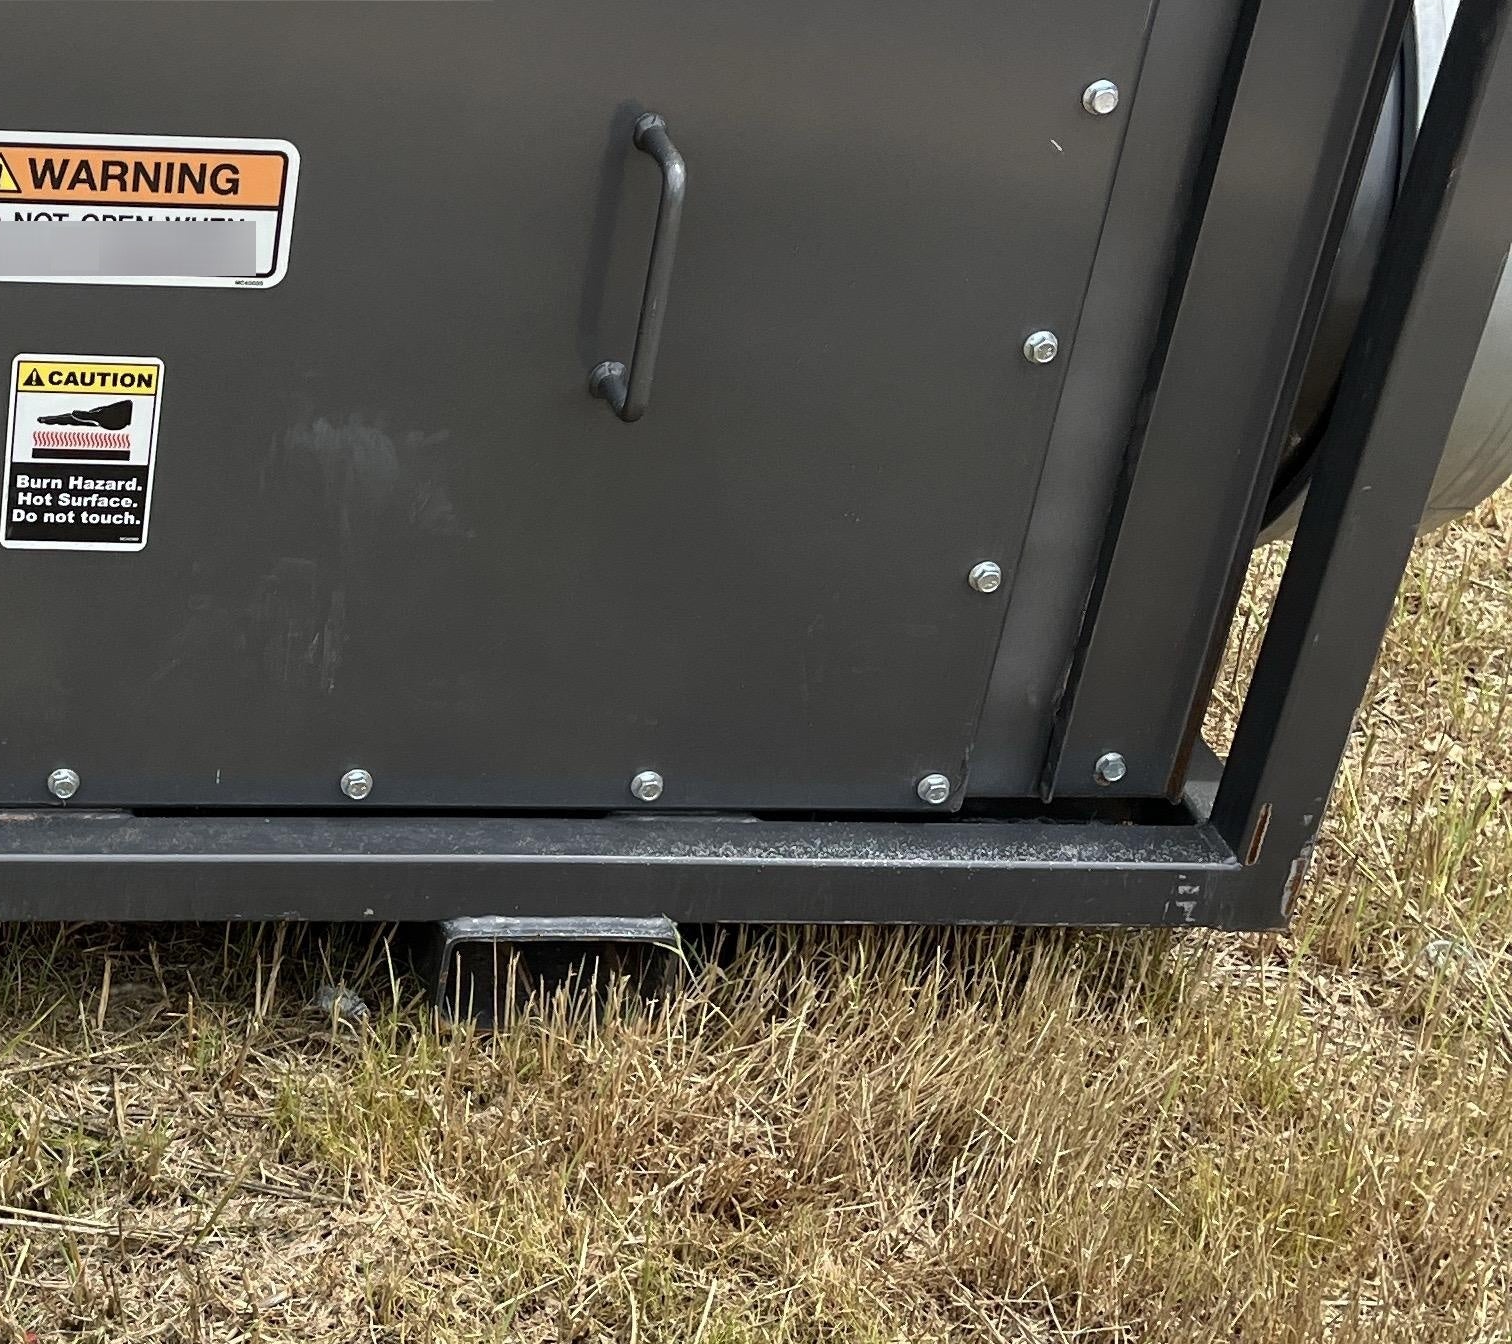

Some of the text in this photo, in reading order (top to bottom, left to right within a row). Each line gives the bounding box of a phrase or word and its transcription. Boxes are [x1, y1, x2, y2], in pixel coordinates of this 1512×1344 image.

[28, 157, 241, 196] WARNING
[47, 369, 154, 390] CAUTION
[16, 474, 143, 492] Burn Hazard.
[17, 491, 138, 508] Hot Surface.
[11, 508, 141, 525] Do not touch.
